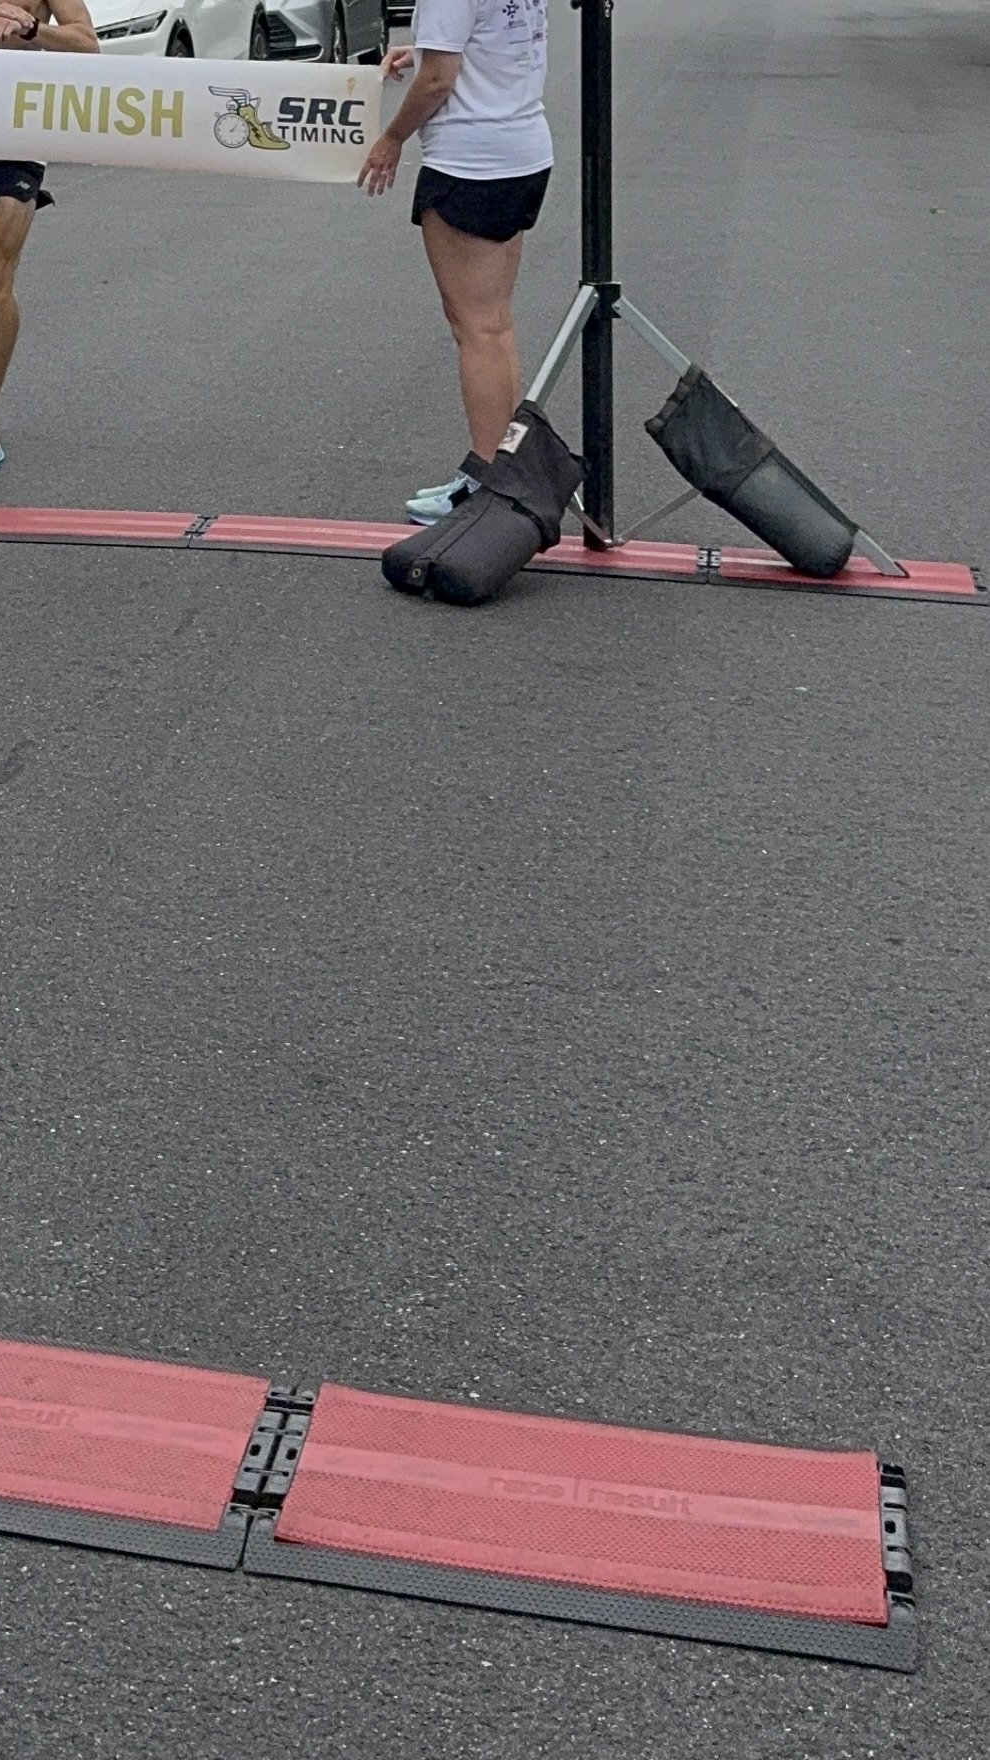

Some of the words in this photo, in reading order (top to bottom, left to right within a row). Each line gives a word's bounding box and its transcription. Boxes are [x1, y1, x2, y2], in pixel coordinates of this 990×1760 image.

[13, 81, 185, 138] FINISH
[277, 96, 365, 126] SRC
[277, 126, 365, 145] TIMING
